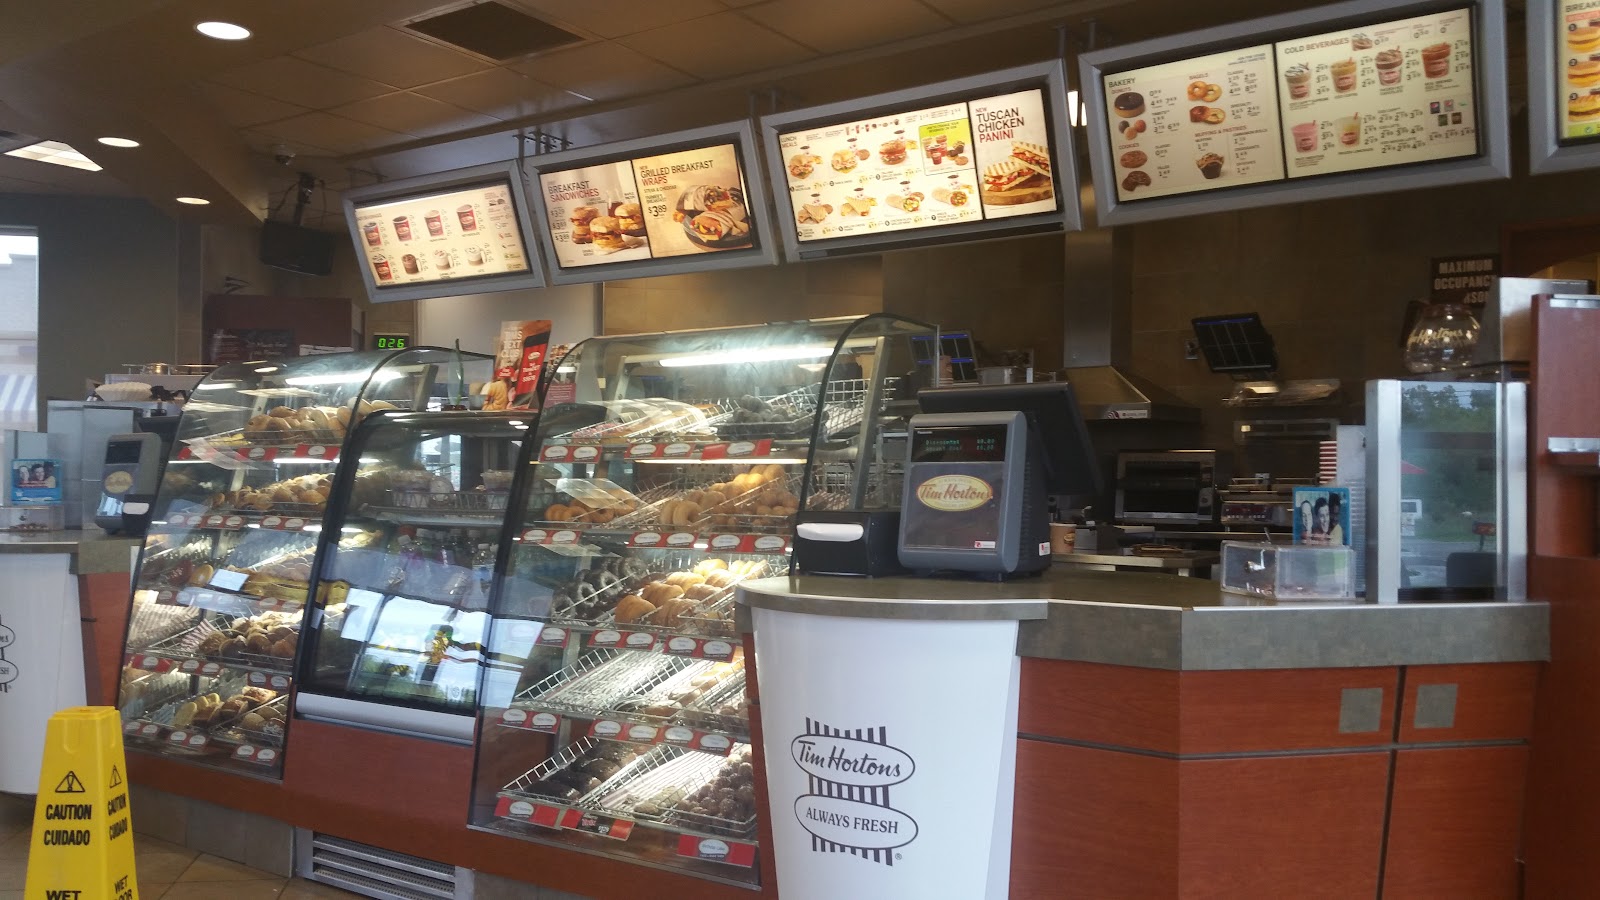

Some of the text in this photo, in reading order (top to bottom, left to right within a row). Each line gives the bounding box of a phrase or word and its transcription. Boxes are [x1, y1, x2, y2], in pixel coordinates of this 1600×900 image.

[1284, 37, 1349, 54] COLD BEVERAGES
[1108, 78, 1136, 88] BAKERY
[976, 107, 1020, 123] TUSCAN
[977, 117, 1025, 133] CHICKEN
[979, 129, 1014, 143] PANINI
[640, 160, 714, 179] GRILLED BREAKFAST
[548, 180, 590, 194] BREAKFAST
[641, 176, 668, 187] WRAPS
[550, 188, 599, 203] SANDWICHES
[1439, 259, 1493, 274] MAXIMUM
[378, 338, 405, 349] 026
[920, 484, 943, 499] Tim
[798, 740, 901, 777] Tim Hortons
[45, 804, 92, 820] CAUTION
[806, 806, 899, 834] ALWAYS FRESH
[44, 829, 90, 846] CUIDADO
[115, 875, 128, 894] WET
